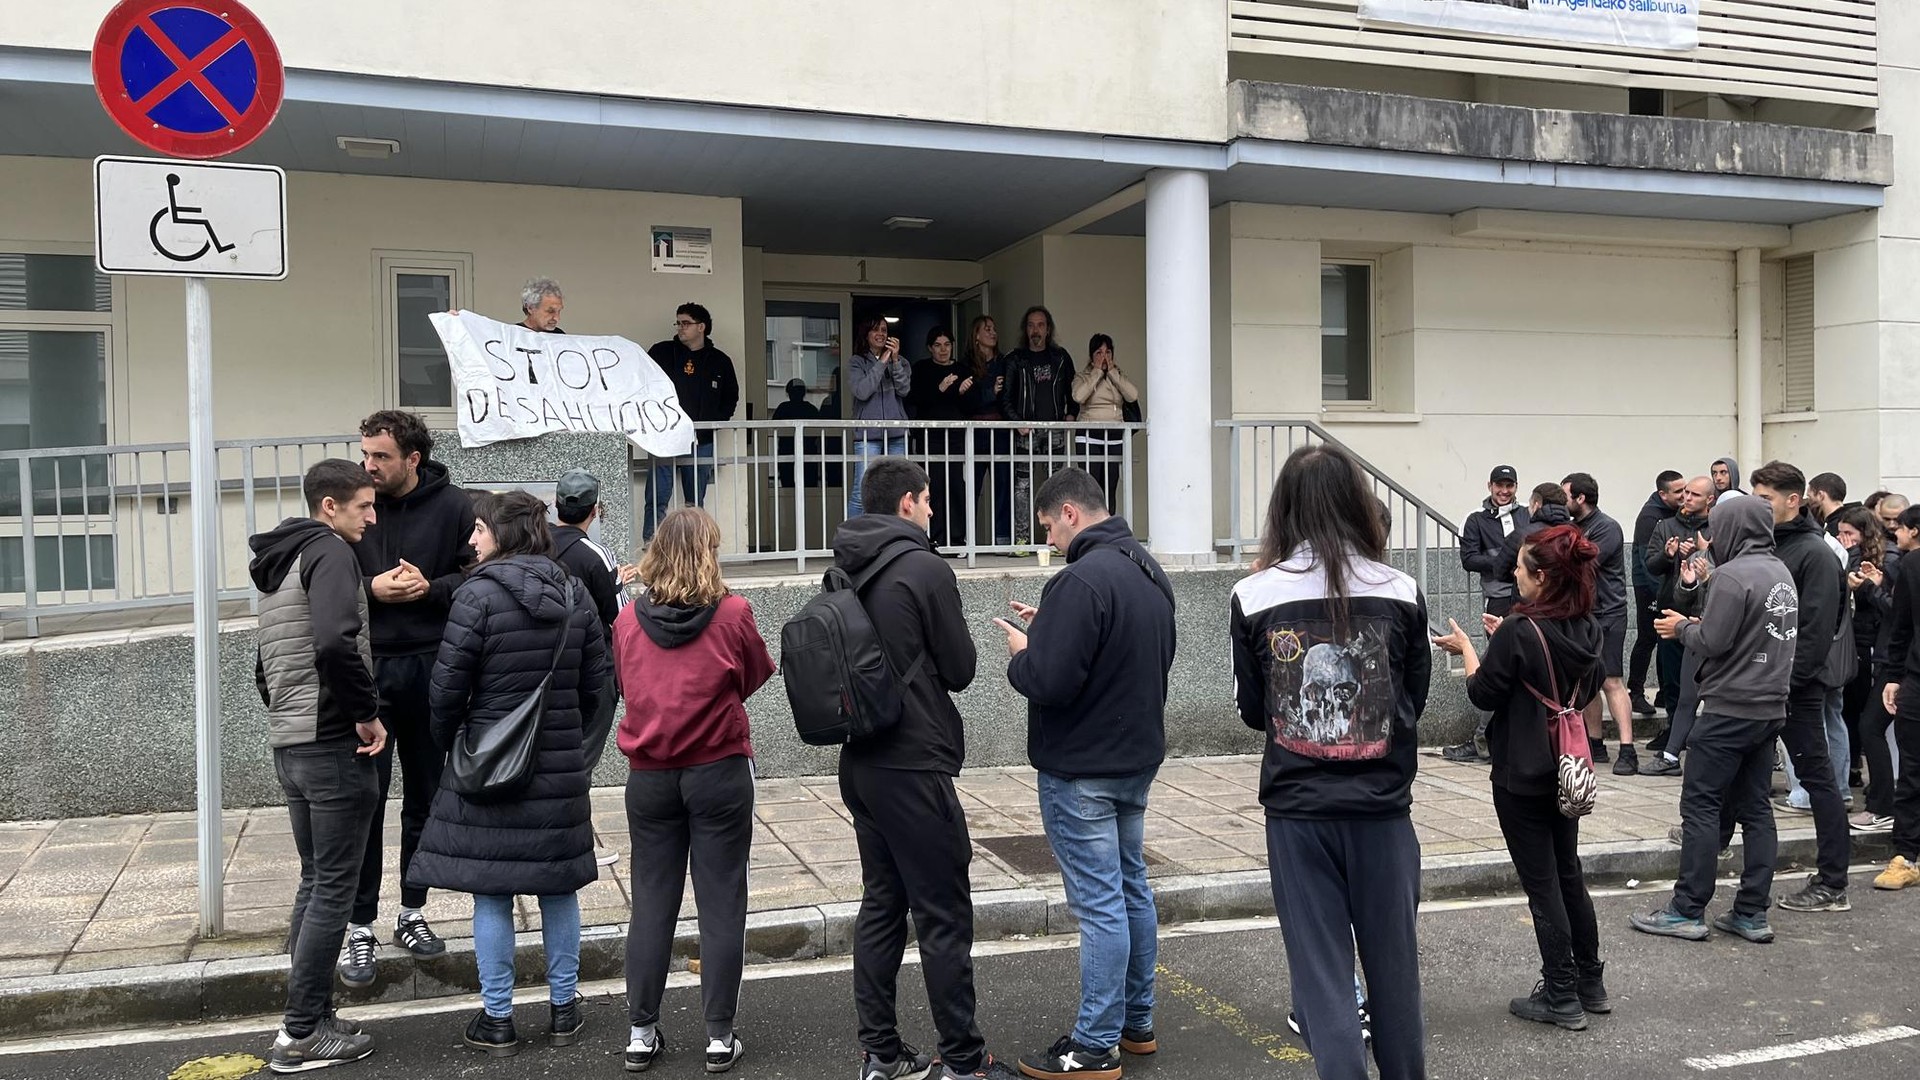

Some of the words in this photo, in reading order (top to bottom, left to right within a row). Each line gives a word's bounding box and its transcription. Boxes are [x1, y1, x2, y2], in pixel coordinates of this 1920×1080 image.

[1628, 0, 1687, 14] sailburua
[857, 259, 868, 282] 1
[485, 340, 620, 391] STOP
[466, 386, 681, 435] DESAHUCIOS
